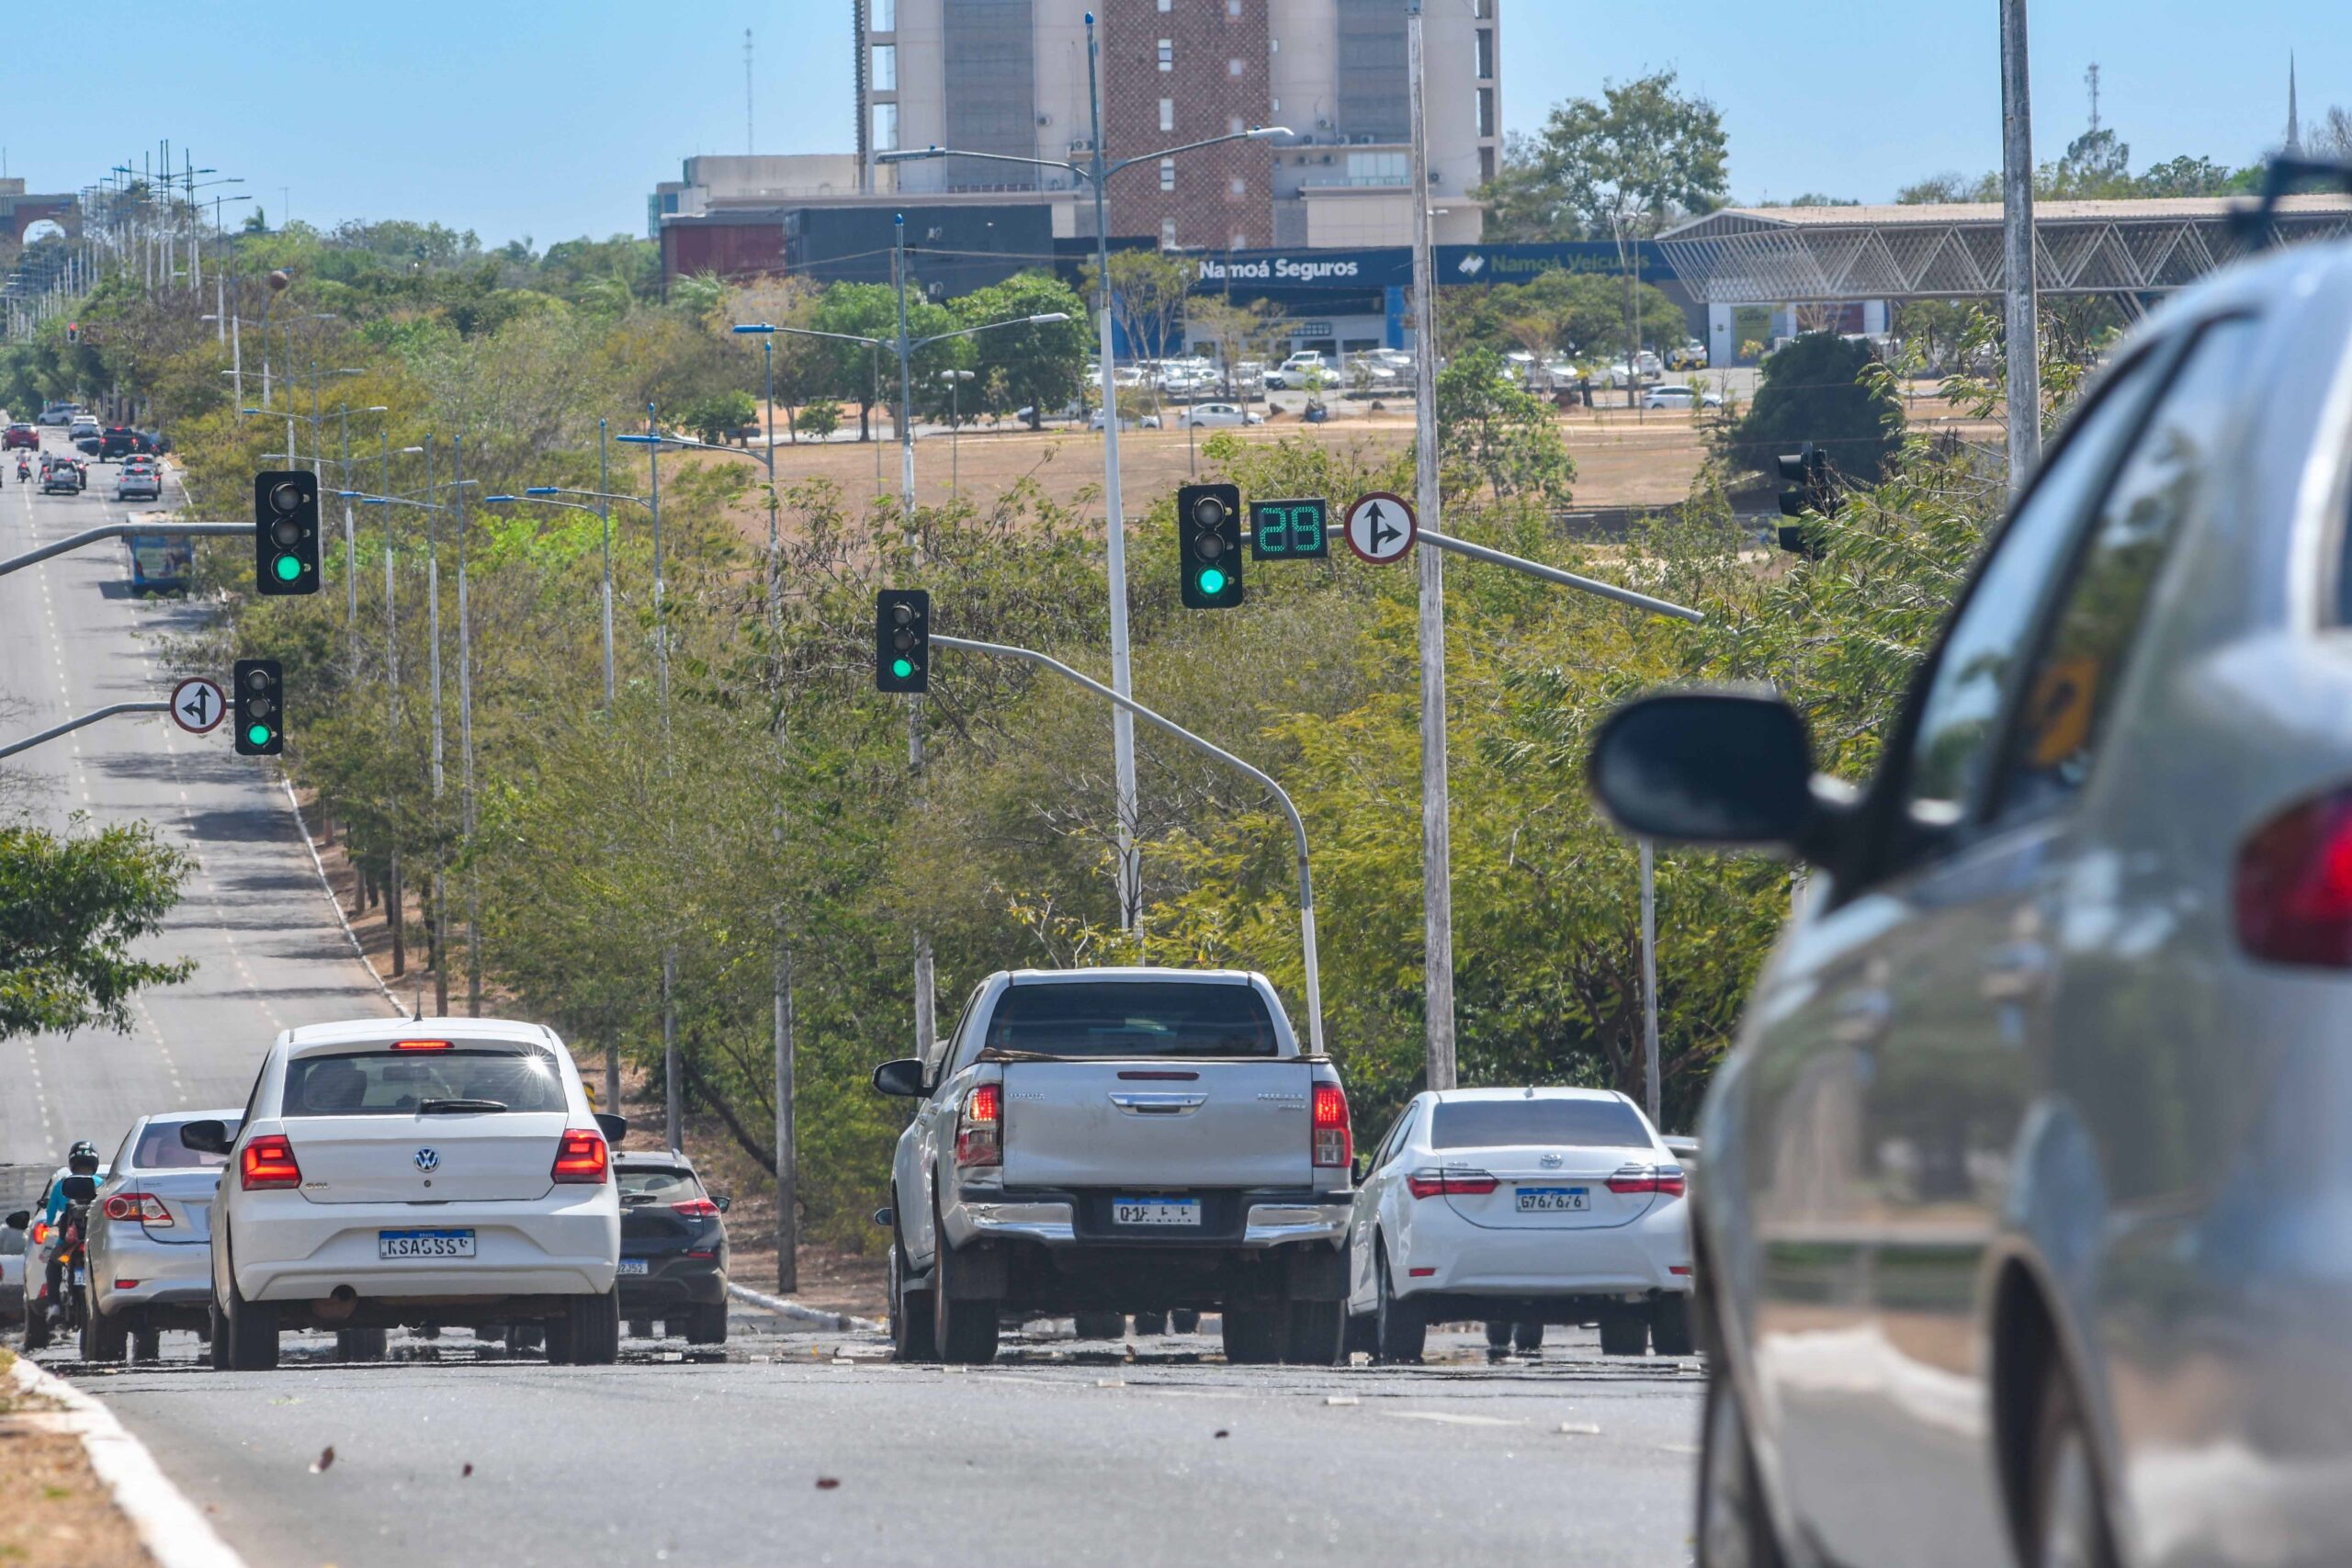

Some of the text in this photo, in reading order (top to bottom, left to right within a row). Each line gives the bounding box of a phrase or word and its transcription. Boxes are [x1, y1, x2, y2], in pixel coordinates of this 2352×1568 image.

[1199, 258, 1359, 281] Namoá Seguros
[1491, 253, 1651, 273] Namoá Veícuos
[1259, 505, 1320, 552] 29
